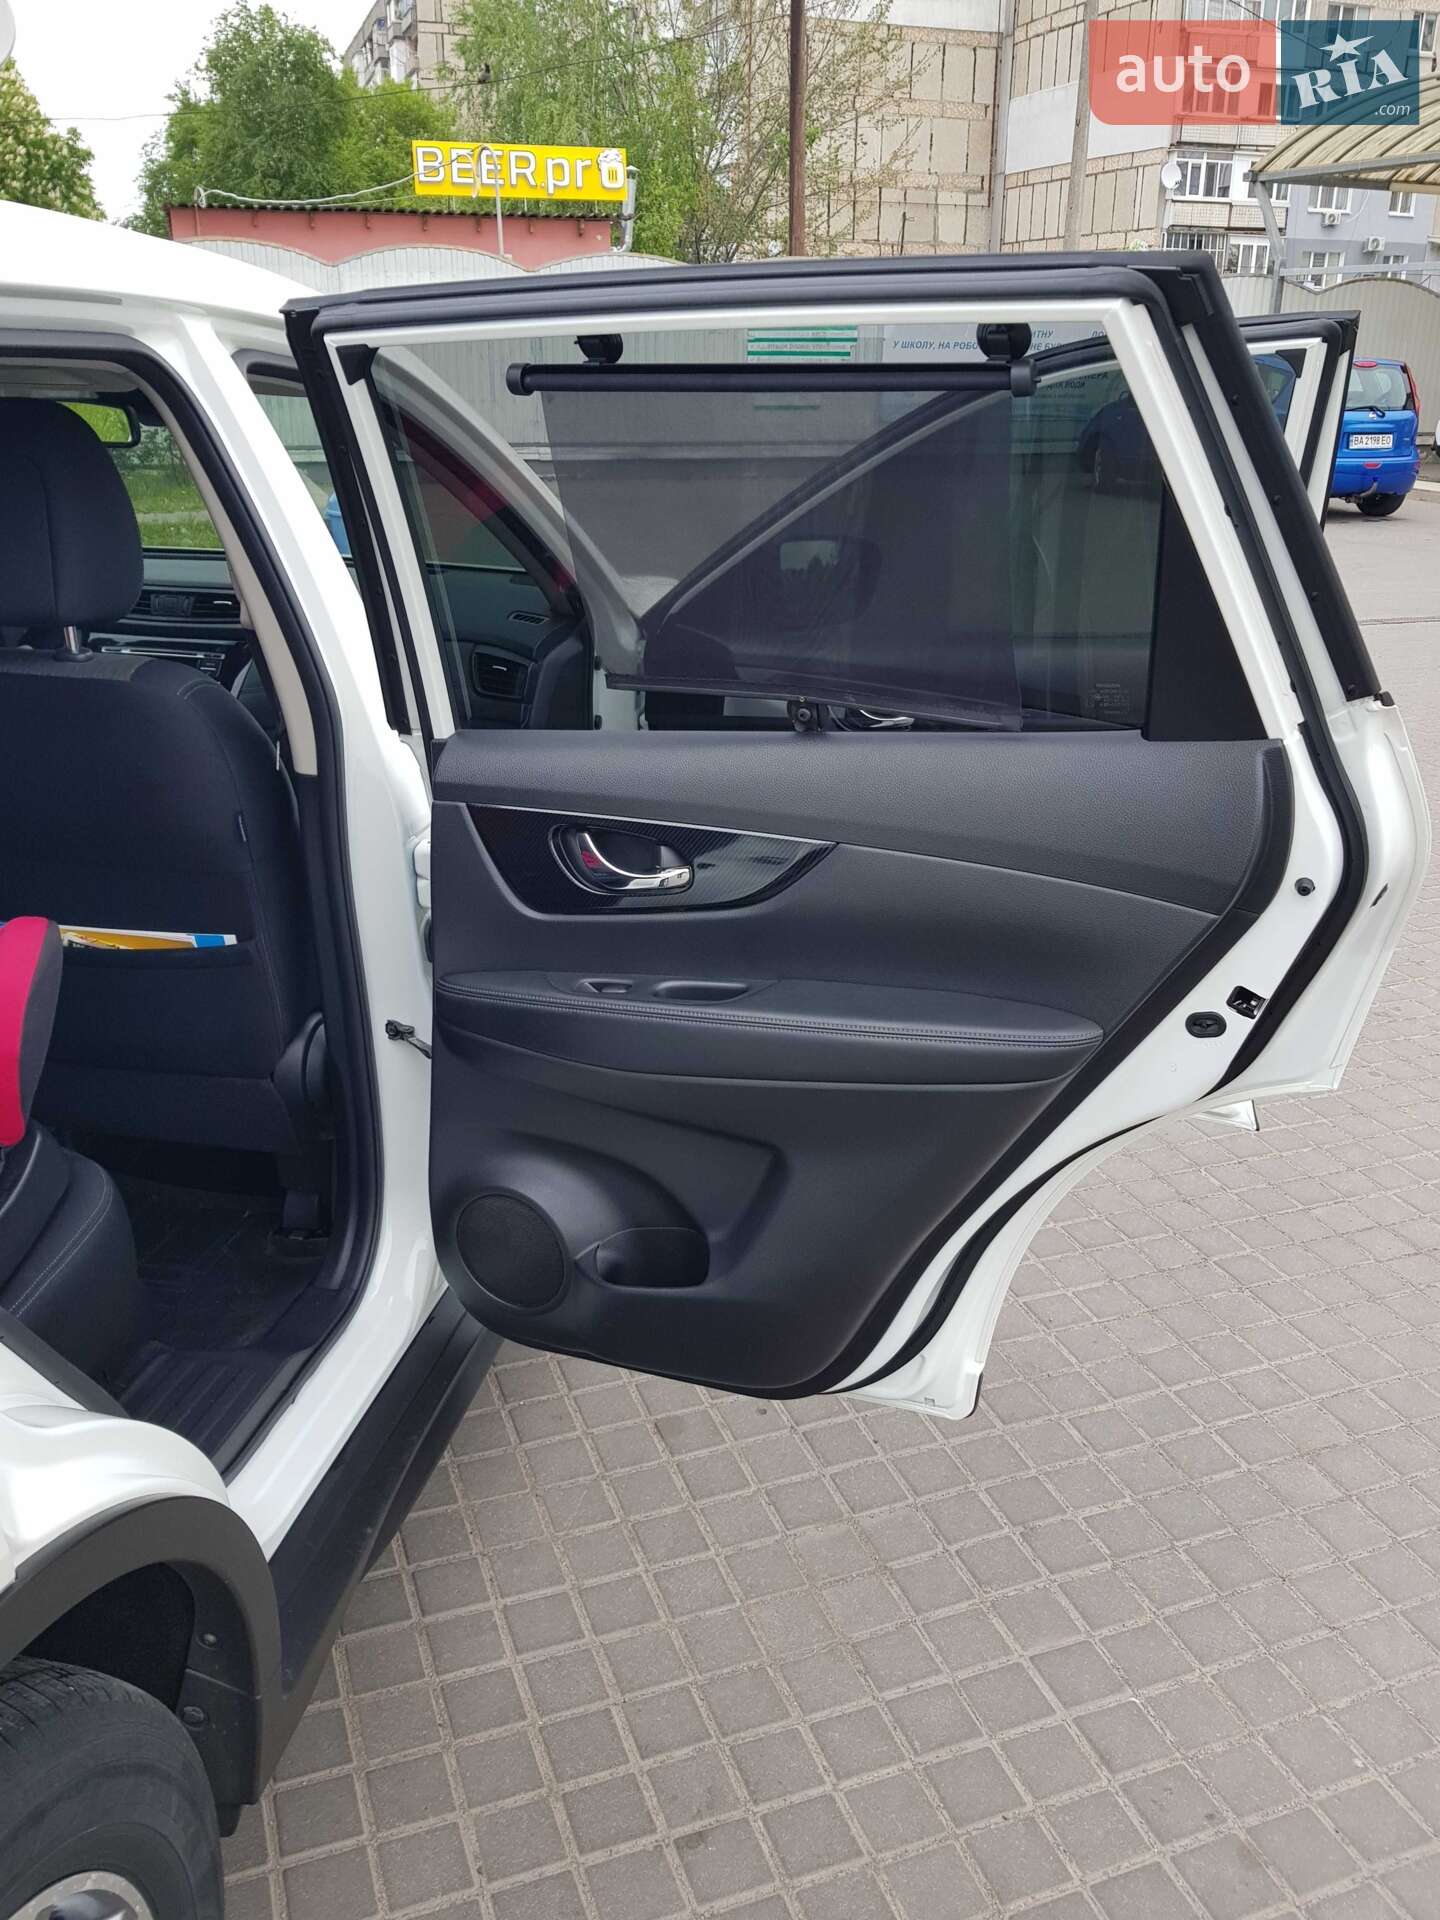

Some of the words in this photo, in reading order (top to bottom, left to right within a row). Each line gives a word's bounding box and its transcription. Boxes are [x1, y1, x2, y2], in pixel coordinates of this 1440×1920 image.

[893, 340, 900, 350] У
[901, 340, 936, 351] ШКОЛУ,
[937, 340, 951, 350] НА
[952, 341, 978, 351] РОБО
